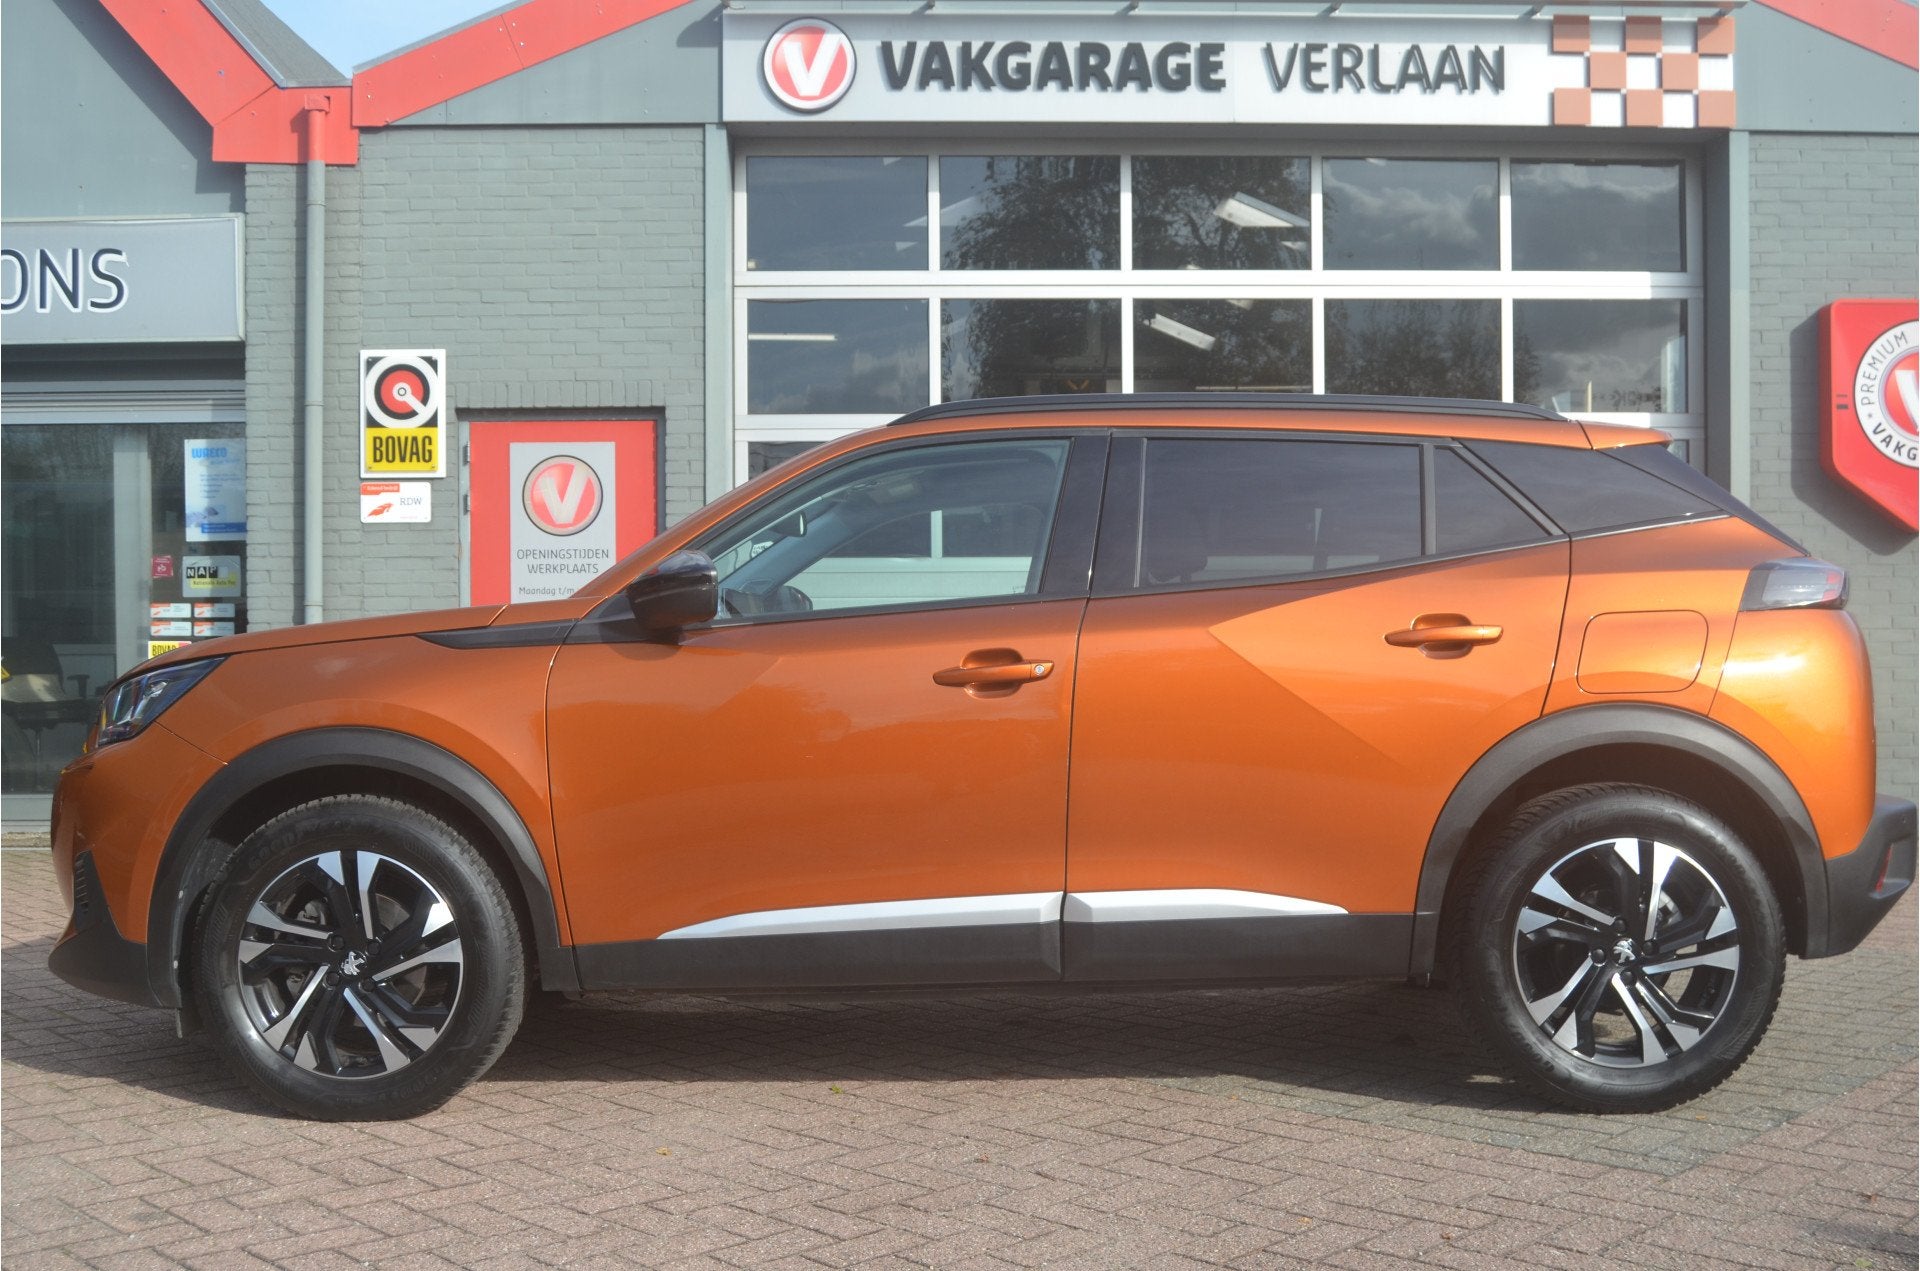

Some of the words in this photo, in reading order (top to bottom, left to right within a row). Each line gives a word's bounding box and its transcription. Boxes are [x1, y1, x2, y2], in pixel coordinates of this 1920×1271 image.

[880, 40, 1227, 91] VAKGARAGE
[1265, 42, 1505, 91] VERLAAN
[1860, 331, 1908, 406] PREMIUM
[373, 435, 432, 463] BOVAG
[399, 497, 422, 506] RDW
[516, 548, 609, 560] OPENINGSTIJDEN
[187, 566, 217, 579] NAP
[527, 563, 599, 574] WERKPLAATS
[518, 587, 556, 597] Maandag
[558, 587, 575, 596] t/m
